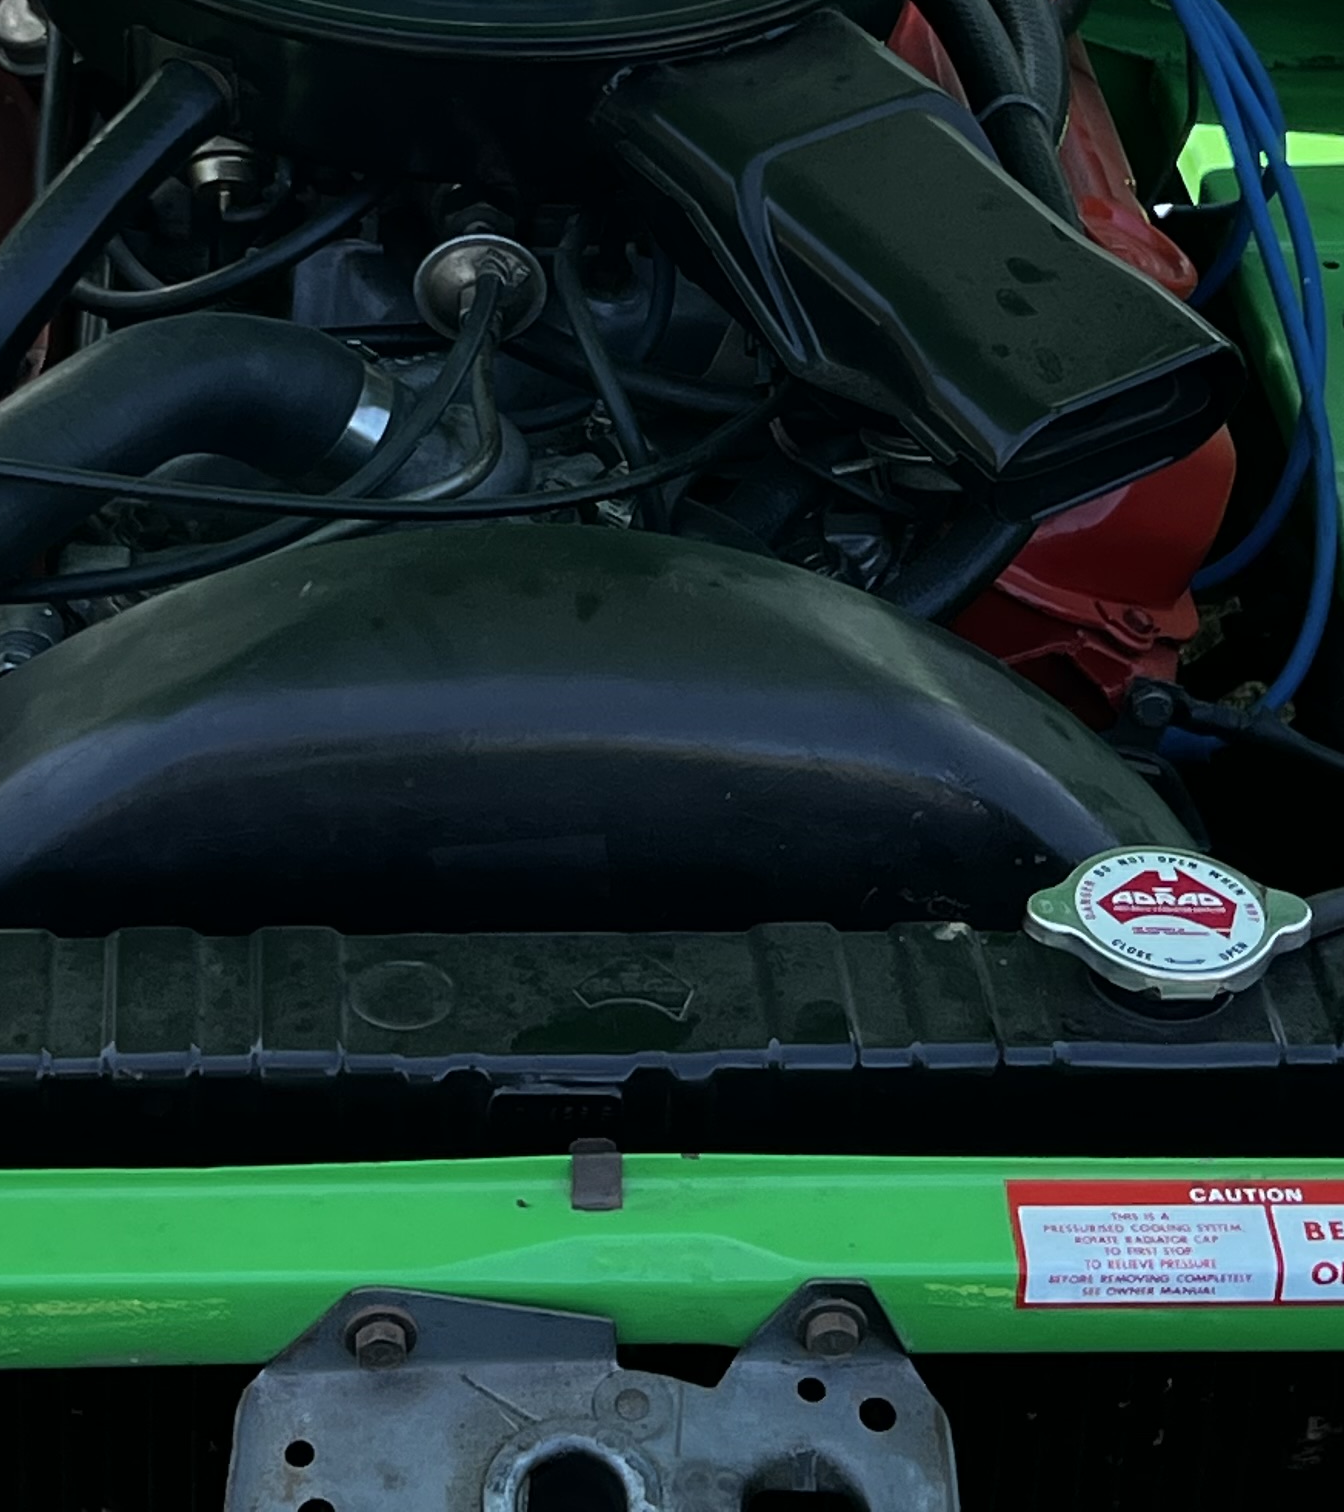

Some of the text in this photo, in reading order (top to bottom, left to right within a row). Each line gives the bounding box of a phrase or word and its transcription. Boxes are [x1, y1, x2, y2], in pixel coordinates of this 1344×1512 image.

[1117, 856, 1146, 866] NOT
[1158, 856, 1198, 869] OPEN
[1111, 888, 1223, 907] ADRAD
[1111, 939, 1154, 961] CLOSE
[1219, 942, 1249, 961] OPEN
[1189, 1186, 1303, 1203] CAUTION
[1111, 1212, 1170, 1221] THIS IS A
[1130, 1224, 1192, 1233] COOLING
[1074, 1235, 1219, 1244] ROTATE RADIATOR CAP
[1105, 1247, 1193, 1256] TO FIRST STOP
[1084, 1259, 1217, 1270] TO RELIEVE PRESSURE
[1048, 1273, 1254, 1284] BEFORE REMOVING COMPLETELY
[1082, 1286, 1217, 1297] SEE OWNER MANUAL
